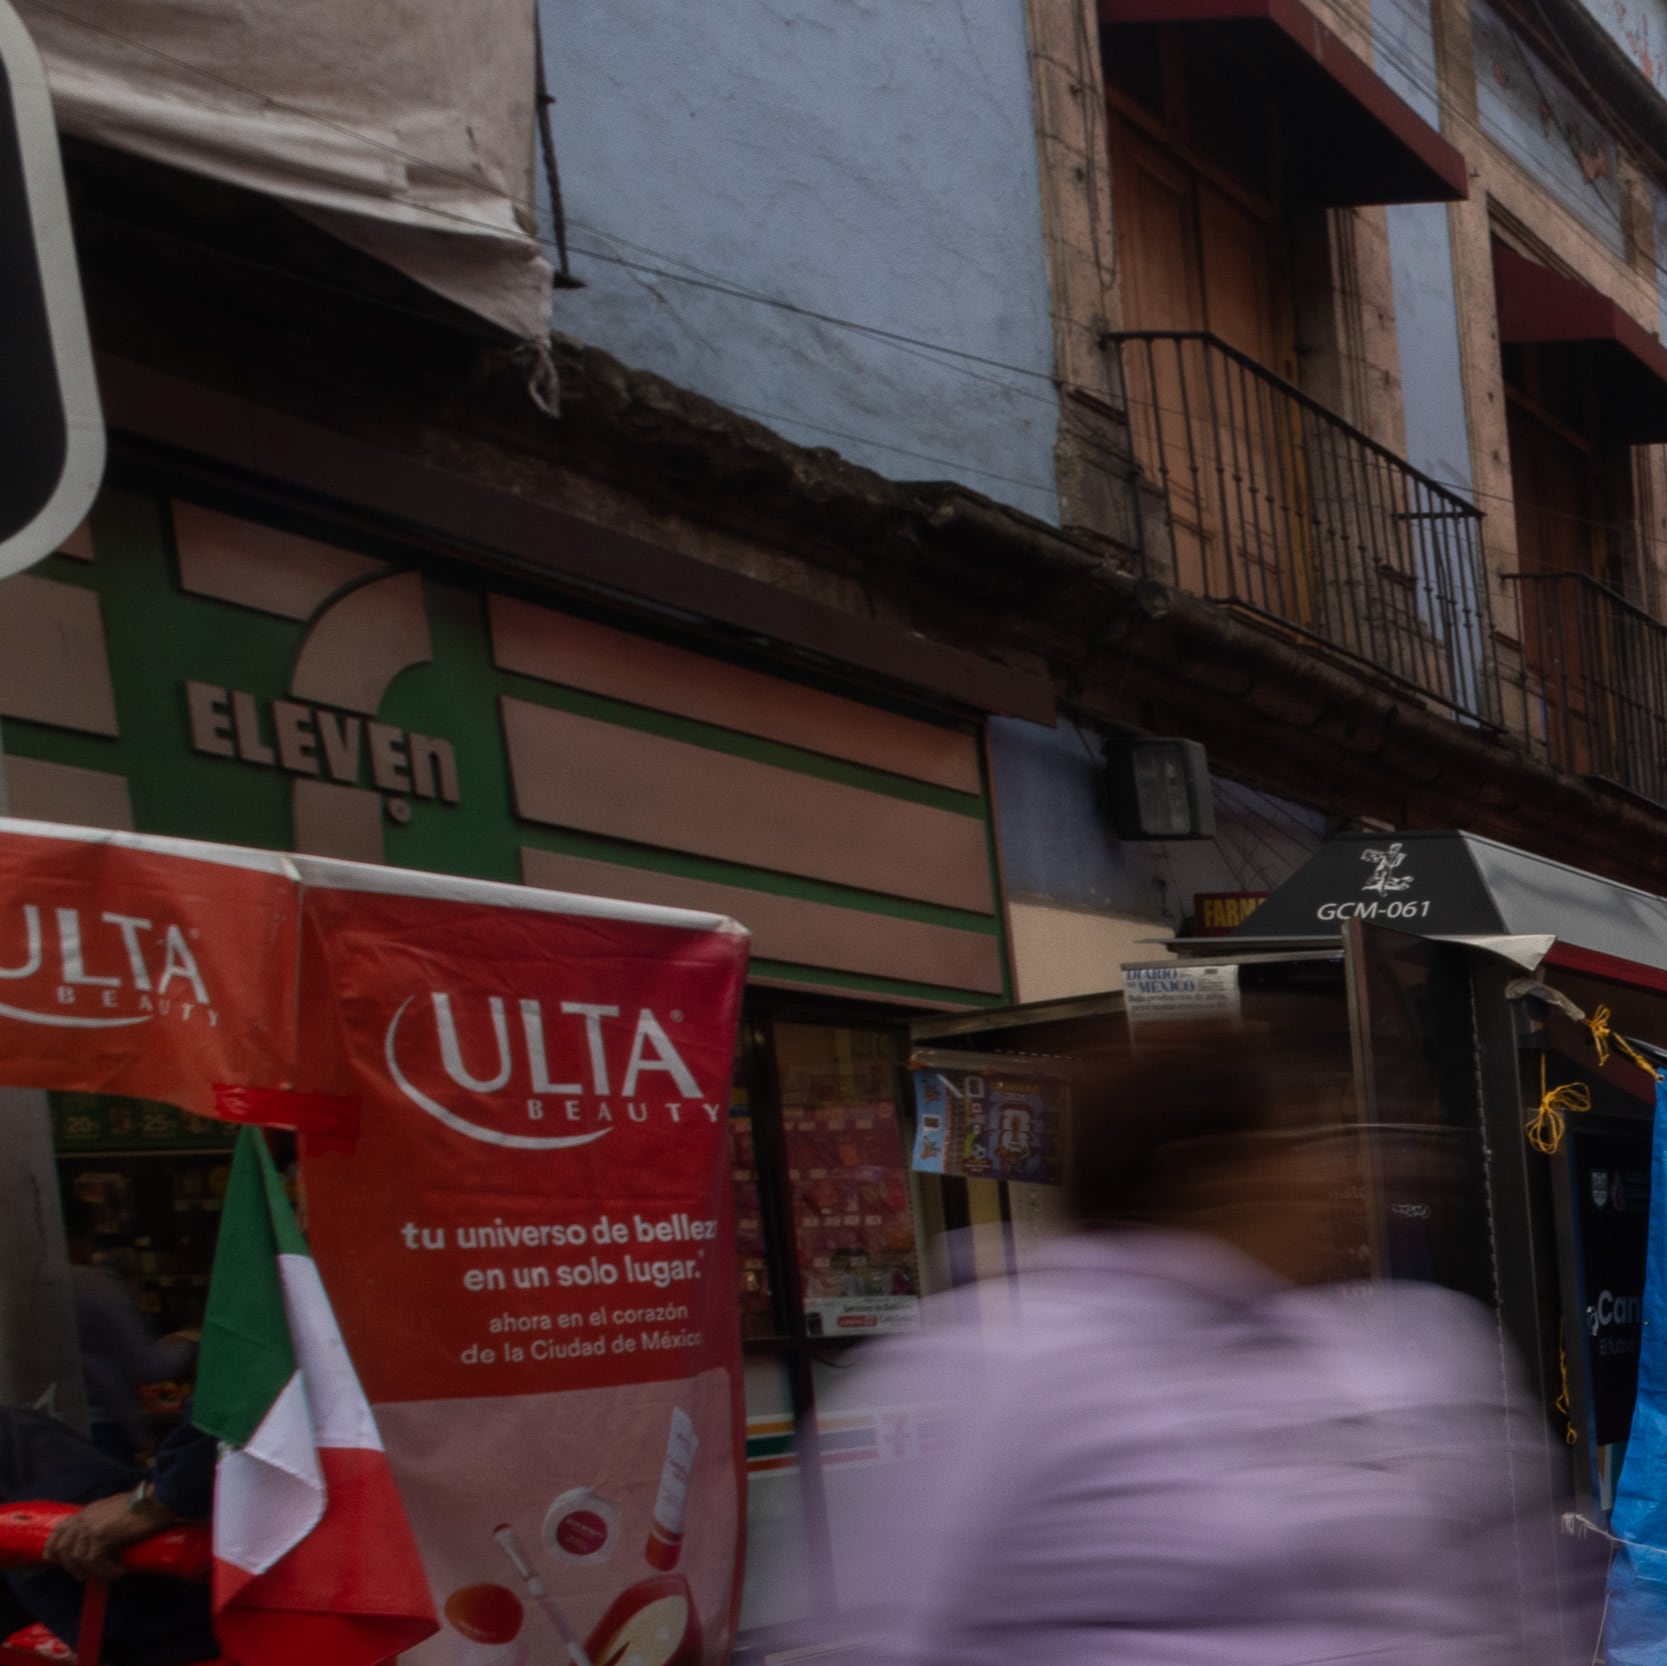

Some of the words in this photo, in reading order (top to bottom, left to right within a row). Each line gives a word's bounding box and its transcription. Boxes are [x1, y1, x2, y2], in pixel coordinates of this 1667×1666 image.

[1203, 897, 1268, 928] FARM
[1316, 900, 1431, 921] GCM-061
[56, 985, 219, 1027] BEAUTY
[430, 991, 705, 1099] ULTA
[527, 1100, 722, 1123] BEAUTY
[400, 1221, 446, 1250] tu
[456, 1217, 587, 1249] universo
[592, 1215, 629, 1245] de
[632, 1212, 719, 1243] bellez
[462, 1265, 506, 1292] en
[512, 1264, 550, 1290] un
[556, 1255, 618, 1287] solo
[489, 1311, 553, 1334] ahora
[557, 1311, 584, 1329] en
[589, 1305, 608, 1327] el
[612, 1302, 689, 1325] corazón
[460, 1342, 497, 1366] de
[503, 1342, 526, 1364] la
[530, 1334, 607, 1361] Ciudad
[611, 1330, 638, 1354] de
